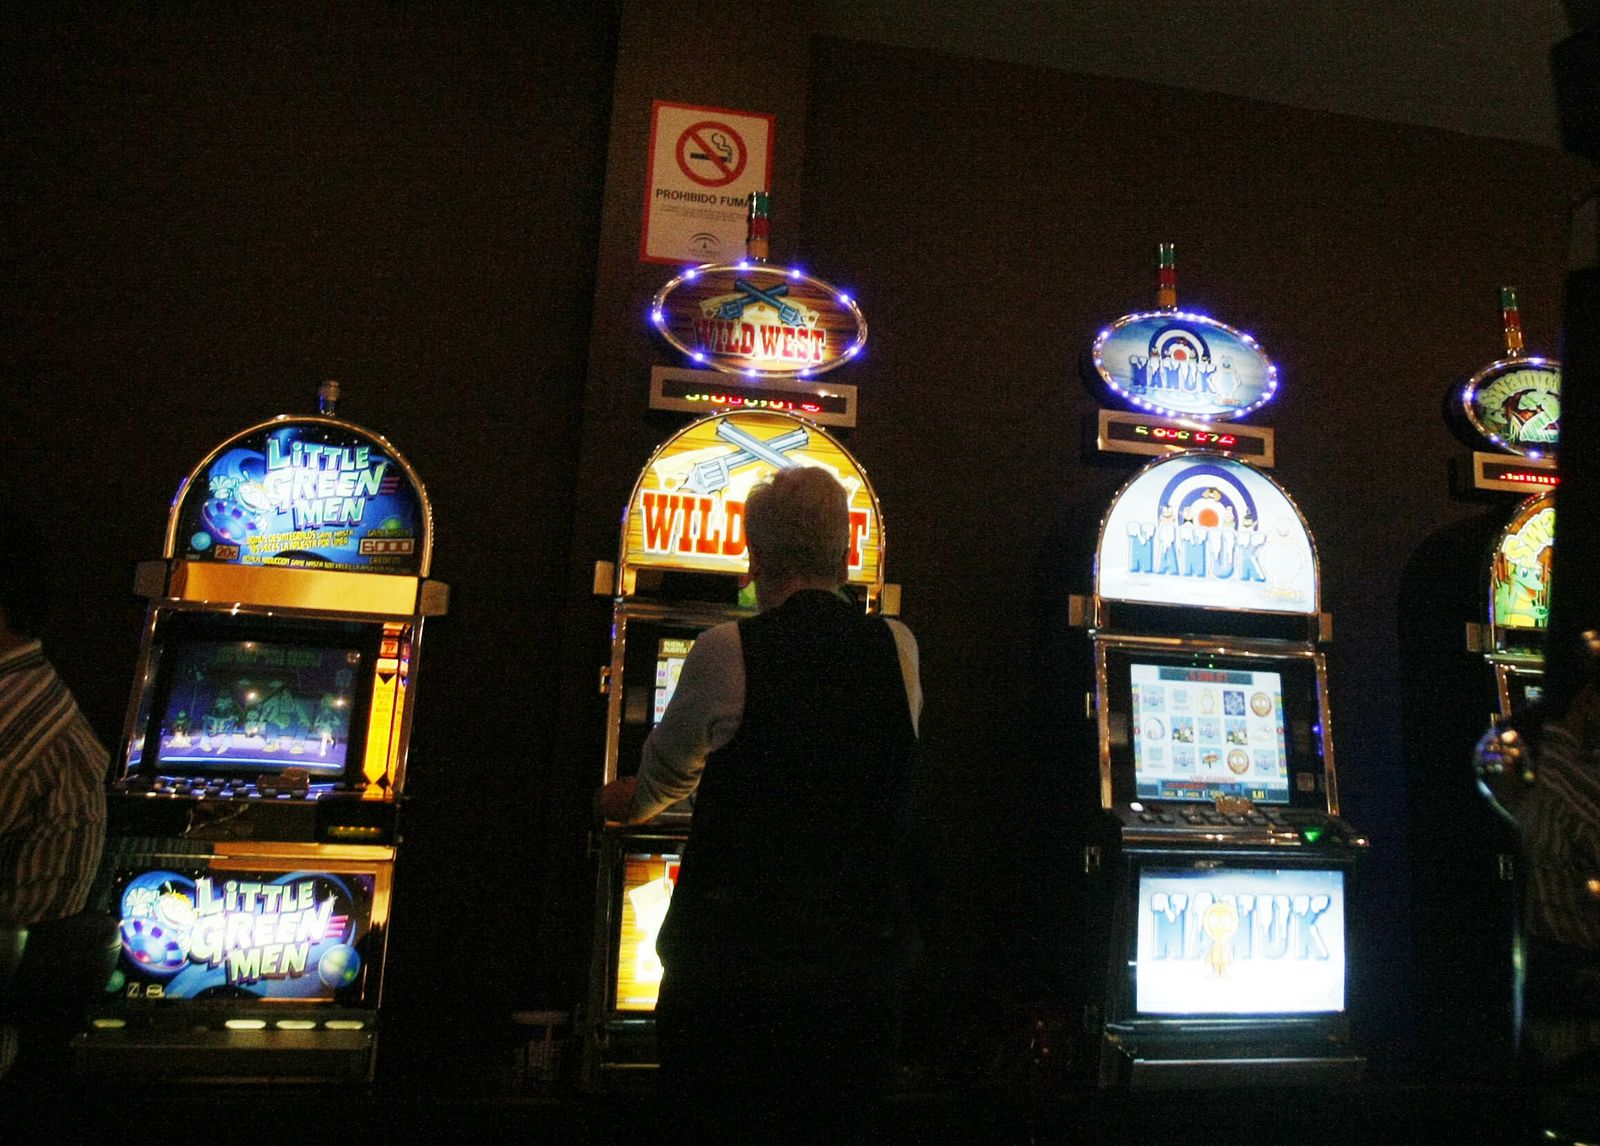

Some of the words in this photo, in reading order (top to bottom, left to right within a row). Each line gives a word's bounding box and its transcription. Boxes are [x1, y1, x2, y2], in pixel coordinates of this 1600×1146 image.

[656, 188, 717, 205] PROHIBIDO
[691, 318, 757, 357] WILD
[759, 323, 827, 363] WEST
[262, 461, 389, 512] GREEN
[293, 497, 367, 530] MEN
[640, 489, 749, 559] WILD
[1126, 521, 1267, 583] NANUK
[189, 894, 337, 965] GREEN
[228, 942, 311, 982] MEN
